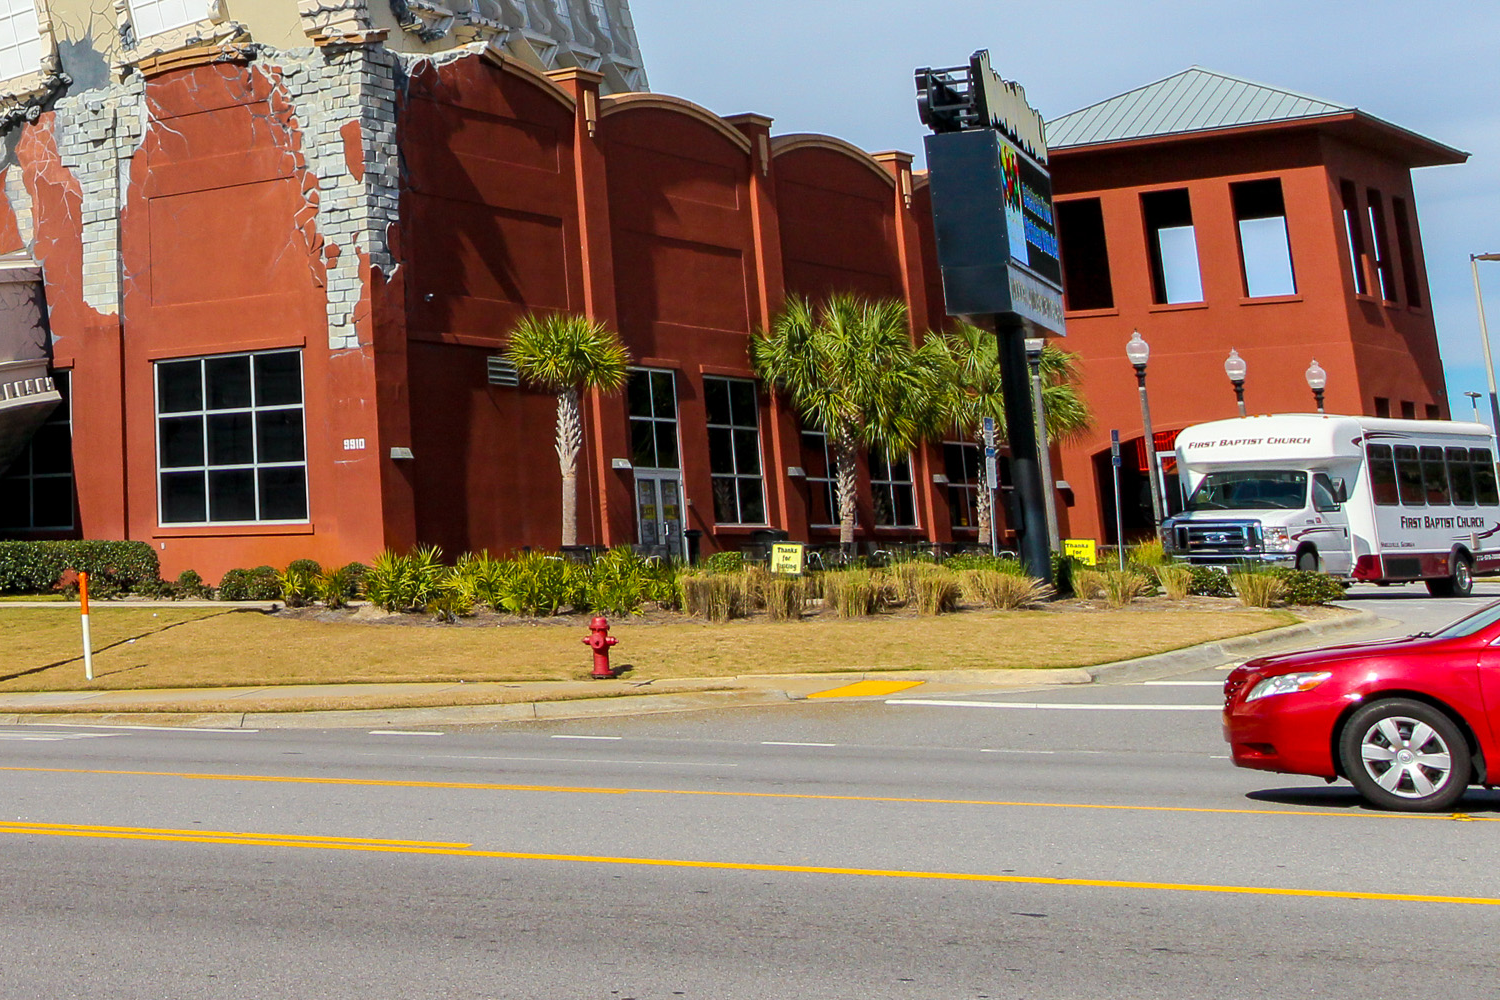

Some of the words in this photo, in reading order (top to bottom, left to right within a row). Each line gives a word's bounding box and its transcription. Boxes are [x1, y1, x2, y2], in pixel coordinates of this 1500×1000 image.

[343, 438, 365, 450] 9910
[1188, 441, 1216, 449] FIRST
[1219, 438, 1263, 447] BAPTIST
[1266, 436, 1311, 444] CHURCH
[1400, 516, 1421, 529] FIRST
[1424, 516, 1455, 529] BAPTIST
[1456, 516, 1484, 528] CHURCH
